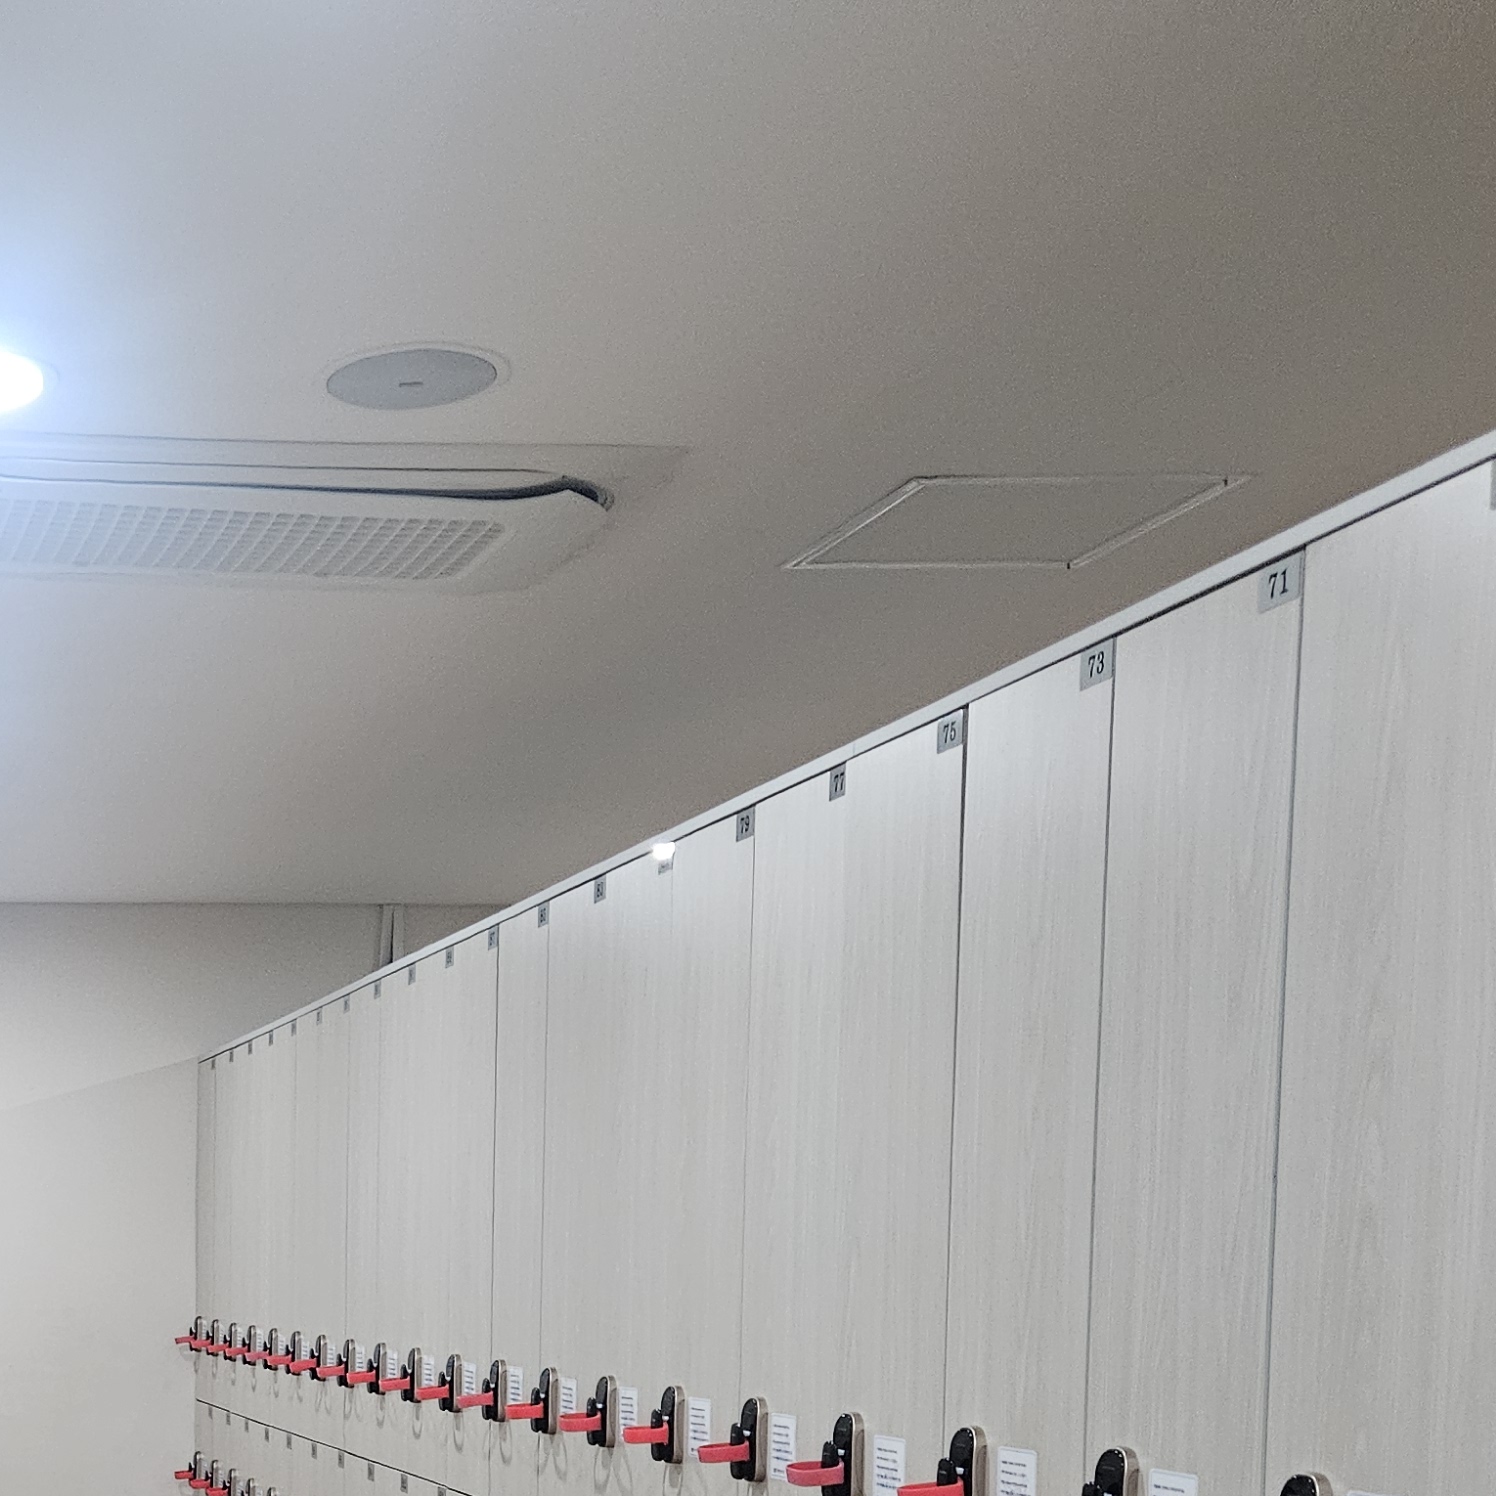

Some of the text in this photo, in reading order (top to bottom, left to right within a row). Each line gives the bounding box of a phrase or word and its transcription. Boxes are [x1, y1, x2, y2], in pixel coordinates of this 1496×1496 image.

[1268, 568, 1289, 599] 71
[1087, 651, 1106, 677] 73
[942, 720, 957, 744] 75
[833, 773, 845, 794] 77
[740, 814, 750, 834] 79
